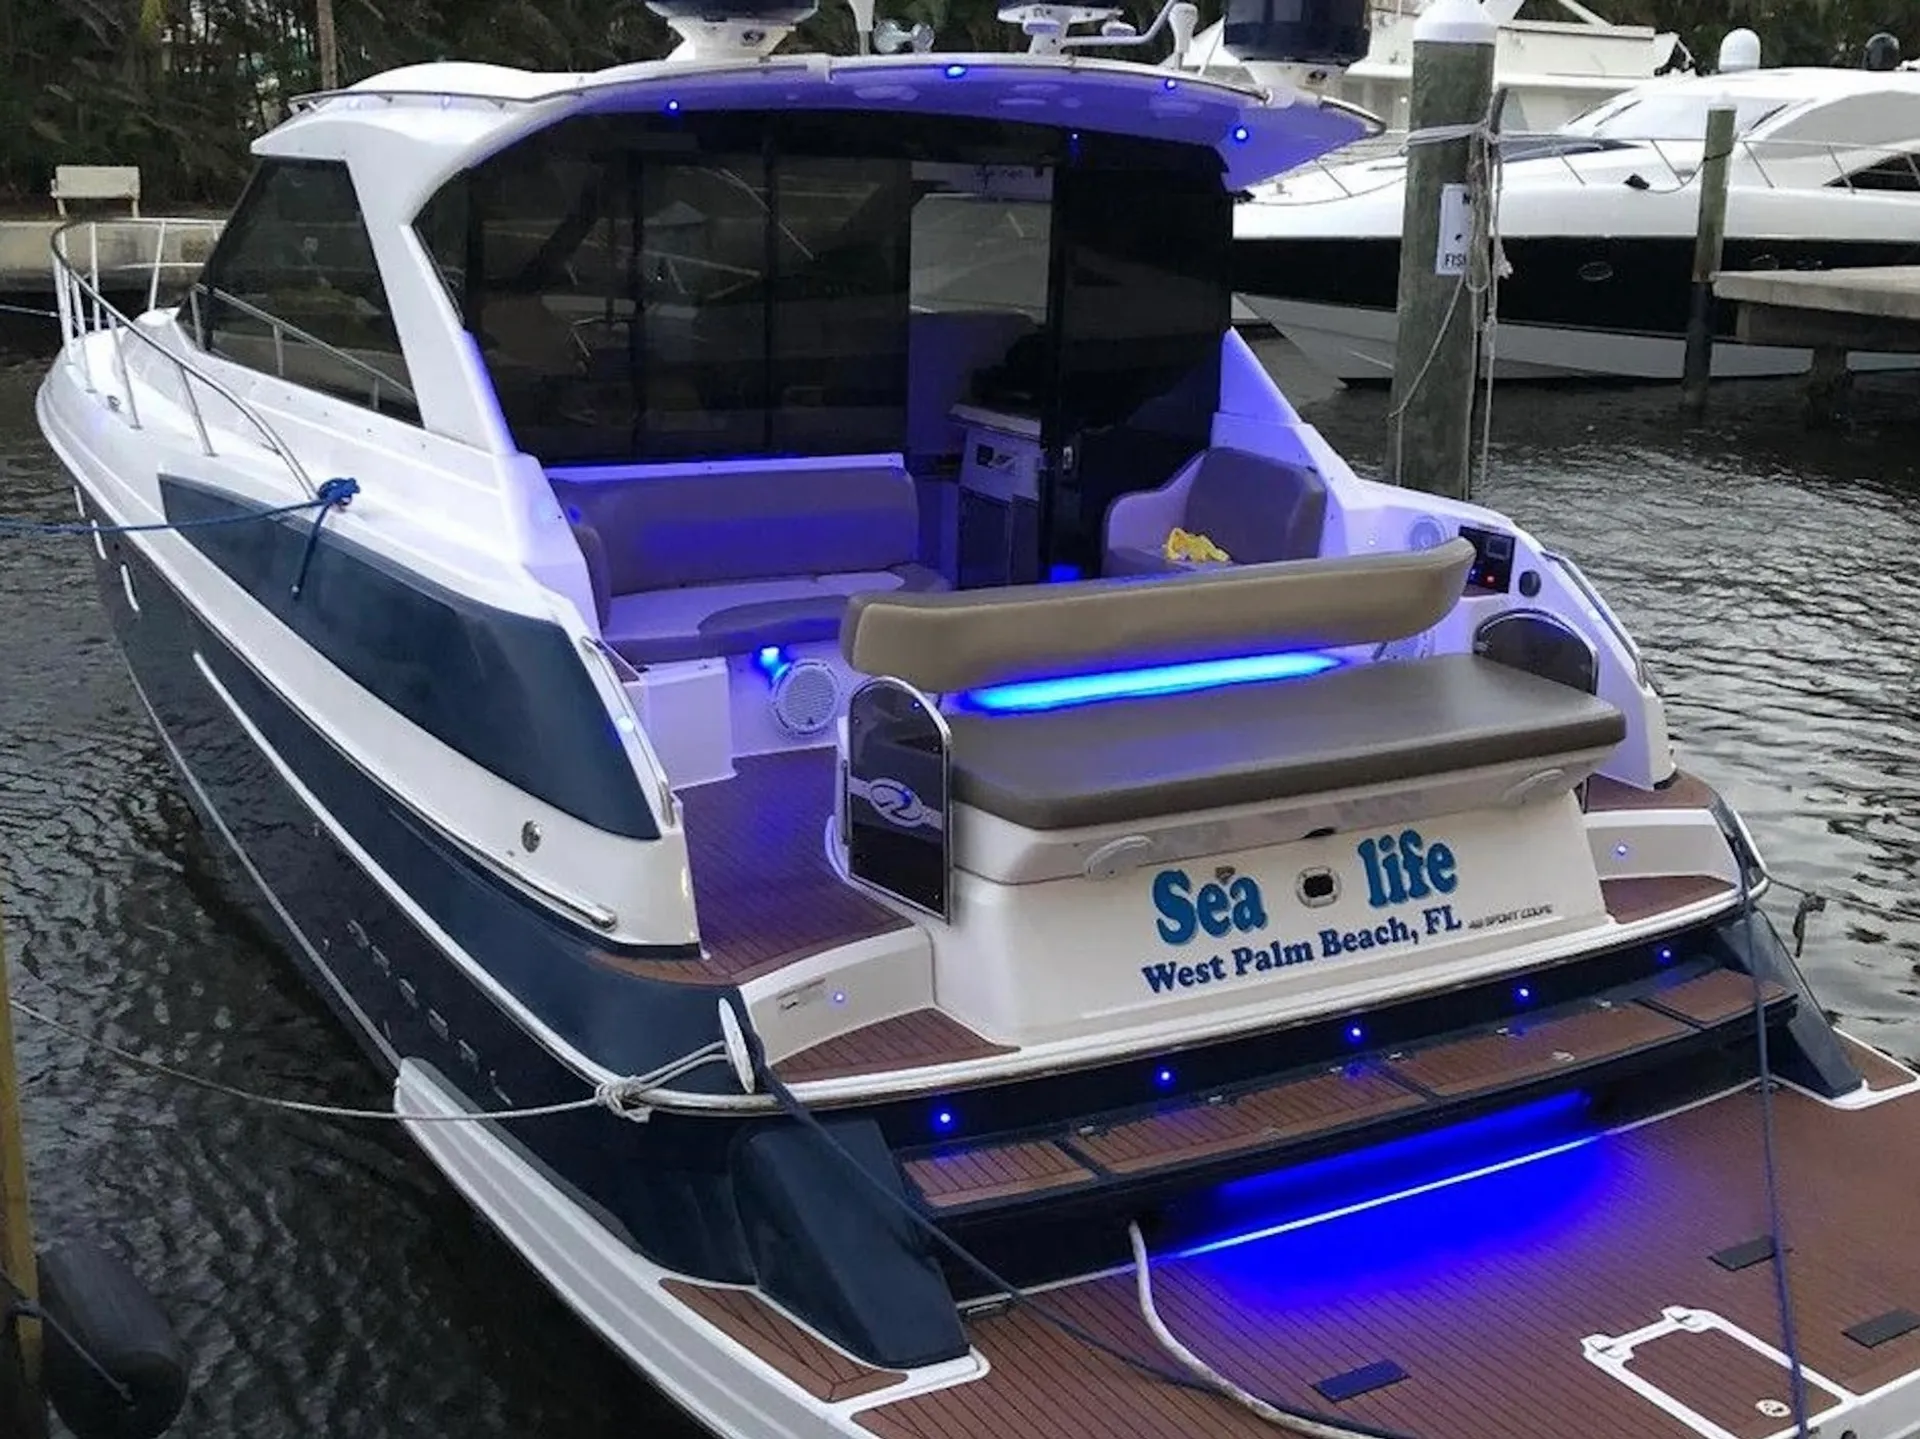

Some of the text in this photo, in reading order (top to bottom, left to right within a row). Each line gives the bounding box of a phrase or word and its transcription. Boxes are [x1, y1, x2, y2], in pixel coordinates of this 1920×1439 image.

[1445, 253, 1467, 267] FIS
[1152, 829, 1458, 945] Sea life
[1142, 905, 1462, 993] West Palm Beach, FL
